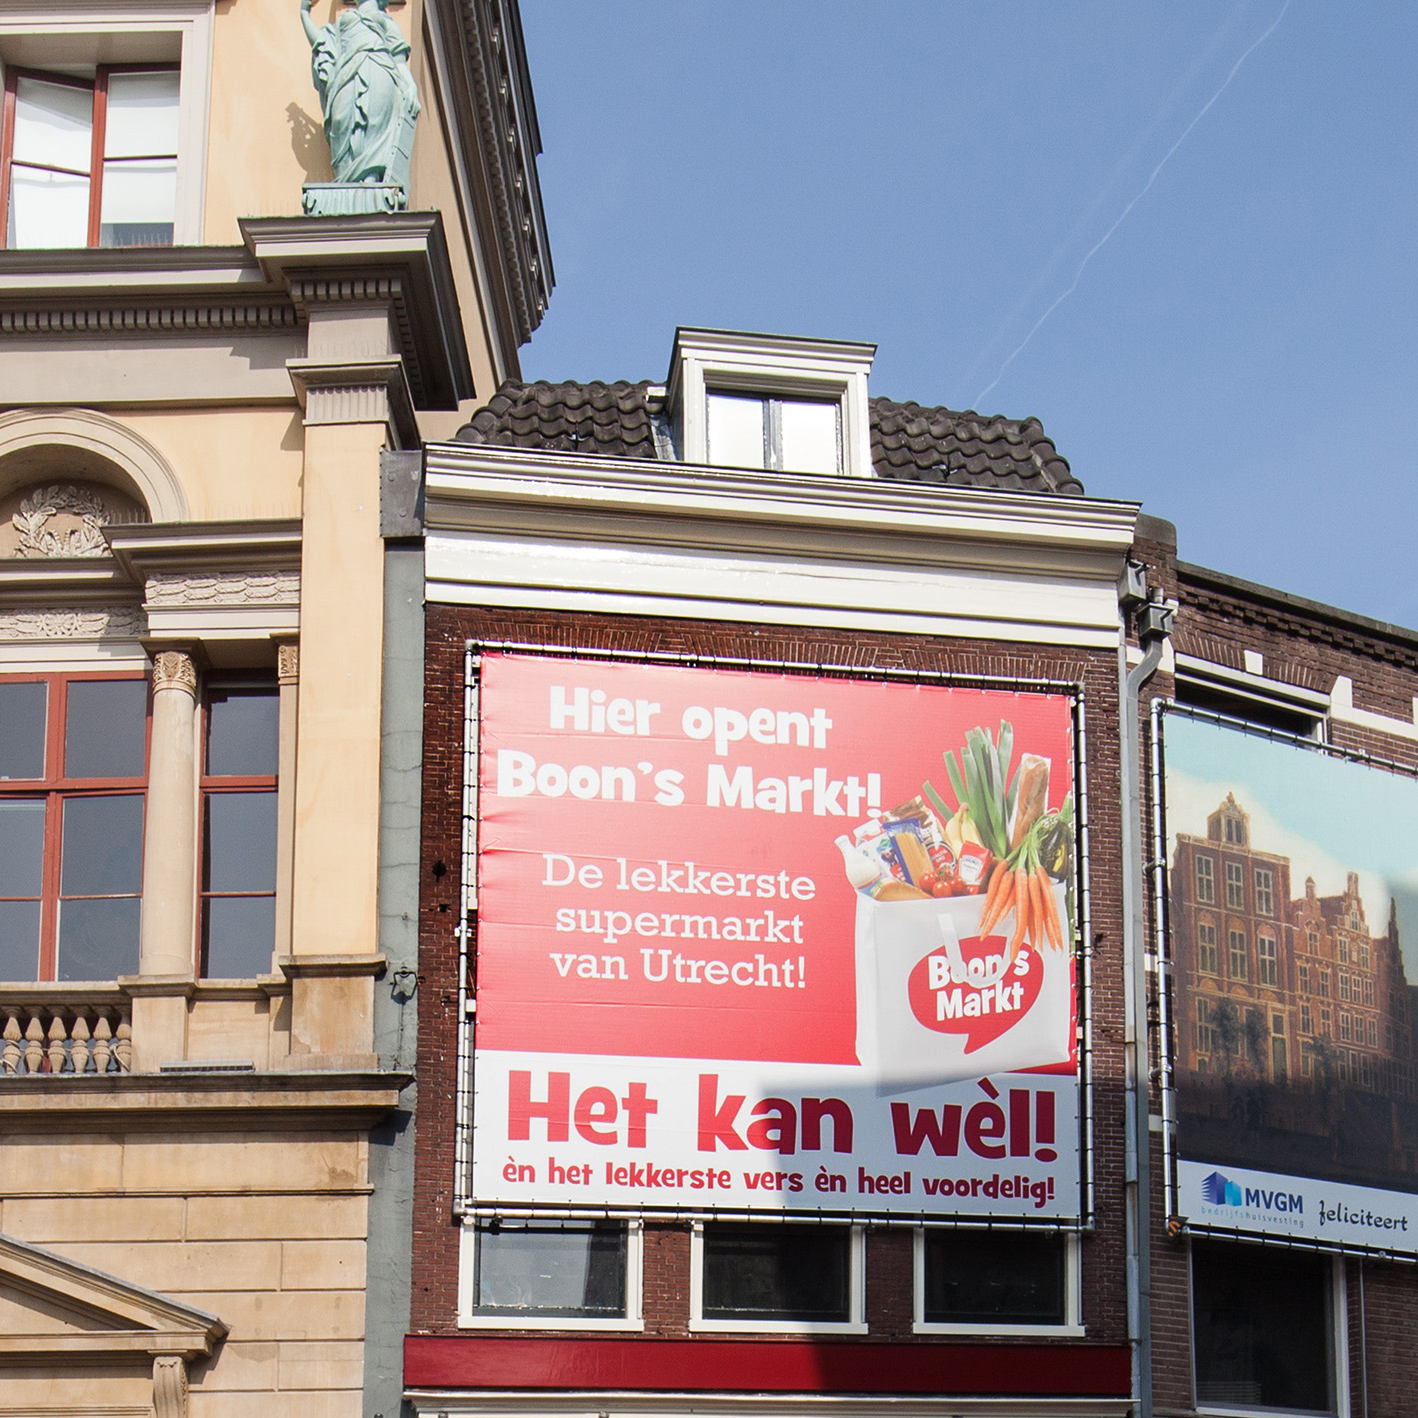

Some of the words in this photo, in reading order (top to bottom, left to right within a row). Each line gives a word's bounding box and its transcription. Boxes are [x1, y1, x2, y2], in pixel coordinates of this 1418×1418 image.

[550, 685, 661, 736] Hier
[682, 705, 833, 756] opent
[497, 749, 684, 806] Boon's
[706, 763, 882, 819] Markt!
[542, 853, 603, 888] De
[616, 857, 816, 901] lekkerste
[555, 907, 804, 944] supermarkt
[549, 952, 629, 980] van
[640, 948, 806, 989] Utrecht!
[928, 950, 1030, 990] Bons
[937, 980, 1024, 1021] Markt
[508, 1070, 658, 1149] Het
[697, 1073, 853, 1155] kan
[890, 1076, 1058, 1163] wèl!
[502, 1156, 535, 1183] èn
[548, 1157, 593, 1185] het
[606, 1162, 731, 1190] lekkerste
[743, 1171, 804, 1192] vers
[814, 1165, 846, 1193] èn
[858, 1166, 911, 1194] heel
[922, 1173, 1055, 1209] voordelig!
[1201, 1206, 1304, 1229] bedrijfshuisvesting
[1245, 1187, 1304, 1214] MVGM
[1319, 1200, 1408, 1231] feliciteert
